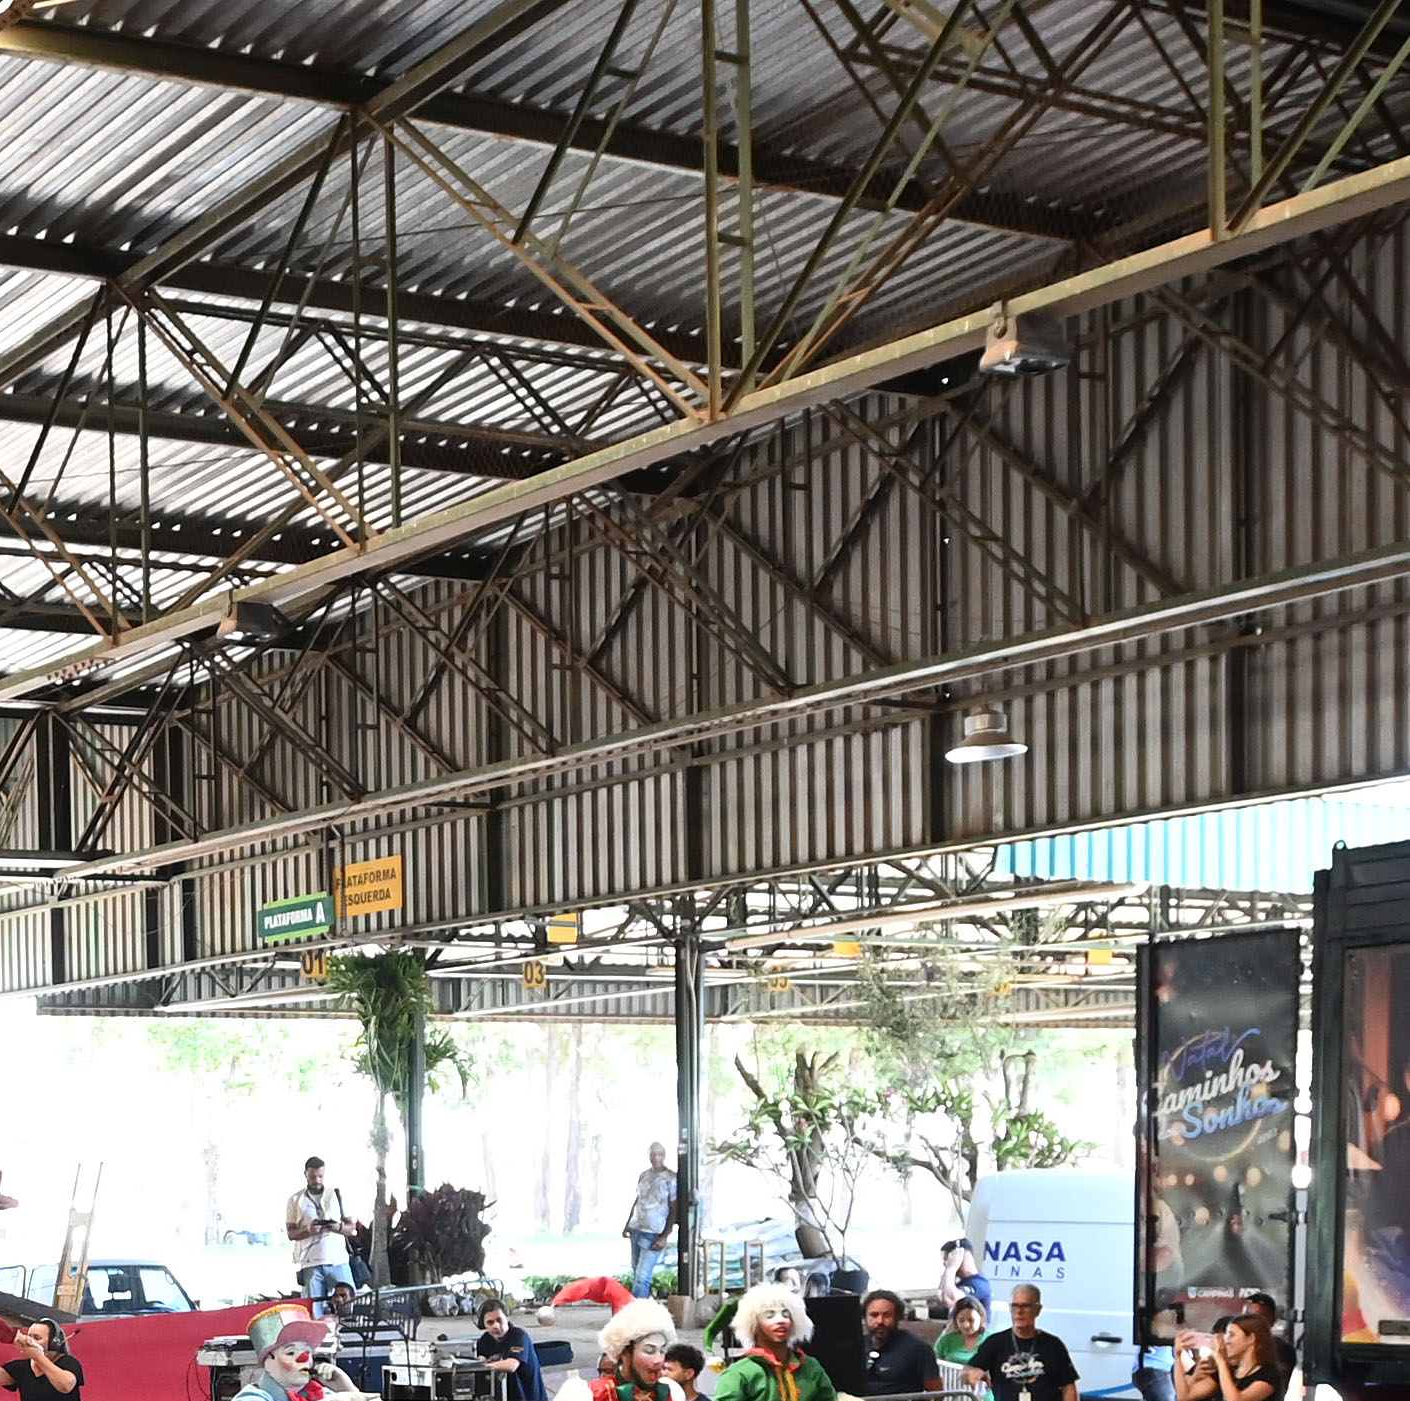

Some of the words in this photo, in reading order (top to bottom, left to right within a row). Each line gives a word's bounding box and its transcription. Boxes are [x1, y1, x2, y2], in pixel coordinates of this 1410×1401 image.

[264, 908, 313, 929] PLATAFORMA
[316, 901, 326, 924] A
[525, 960, 544, 984] 03
[1181, 1081, 1289, 1139] Sonhos
[984, 1241, 1066, 1262] NASA
